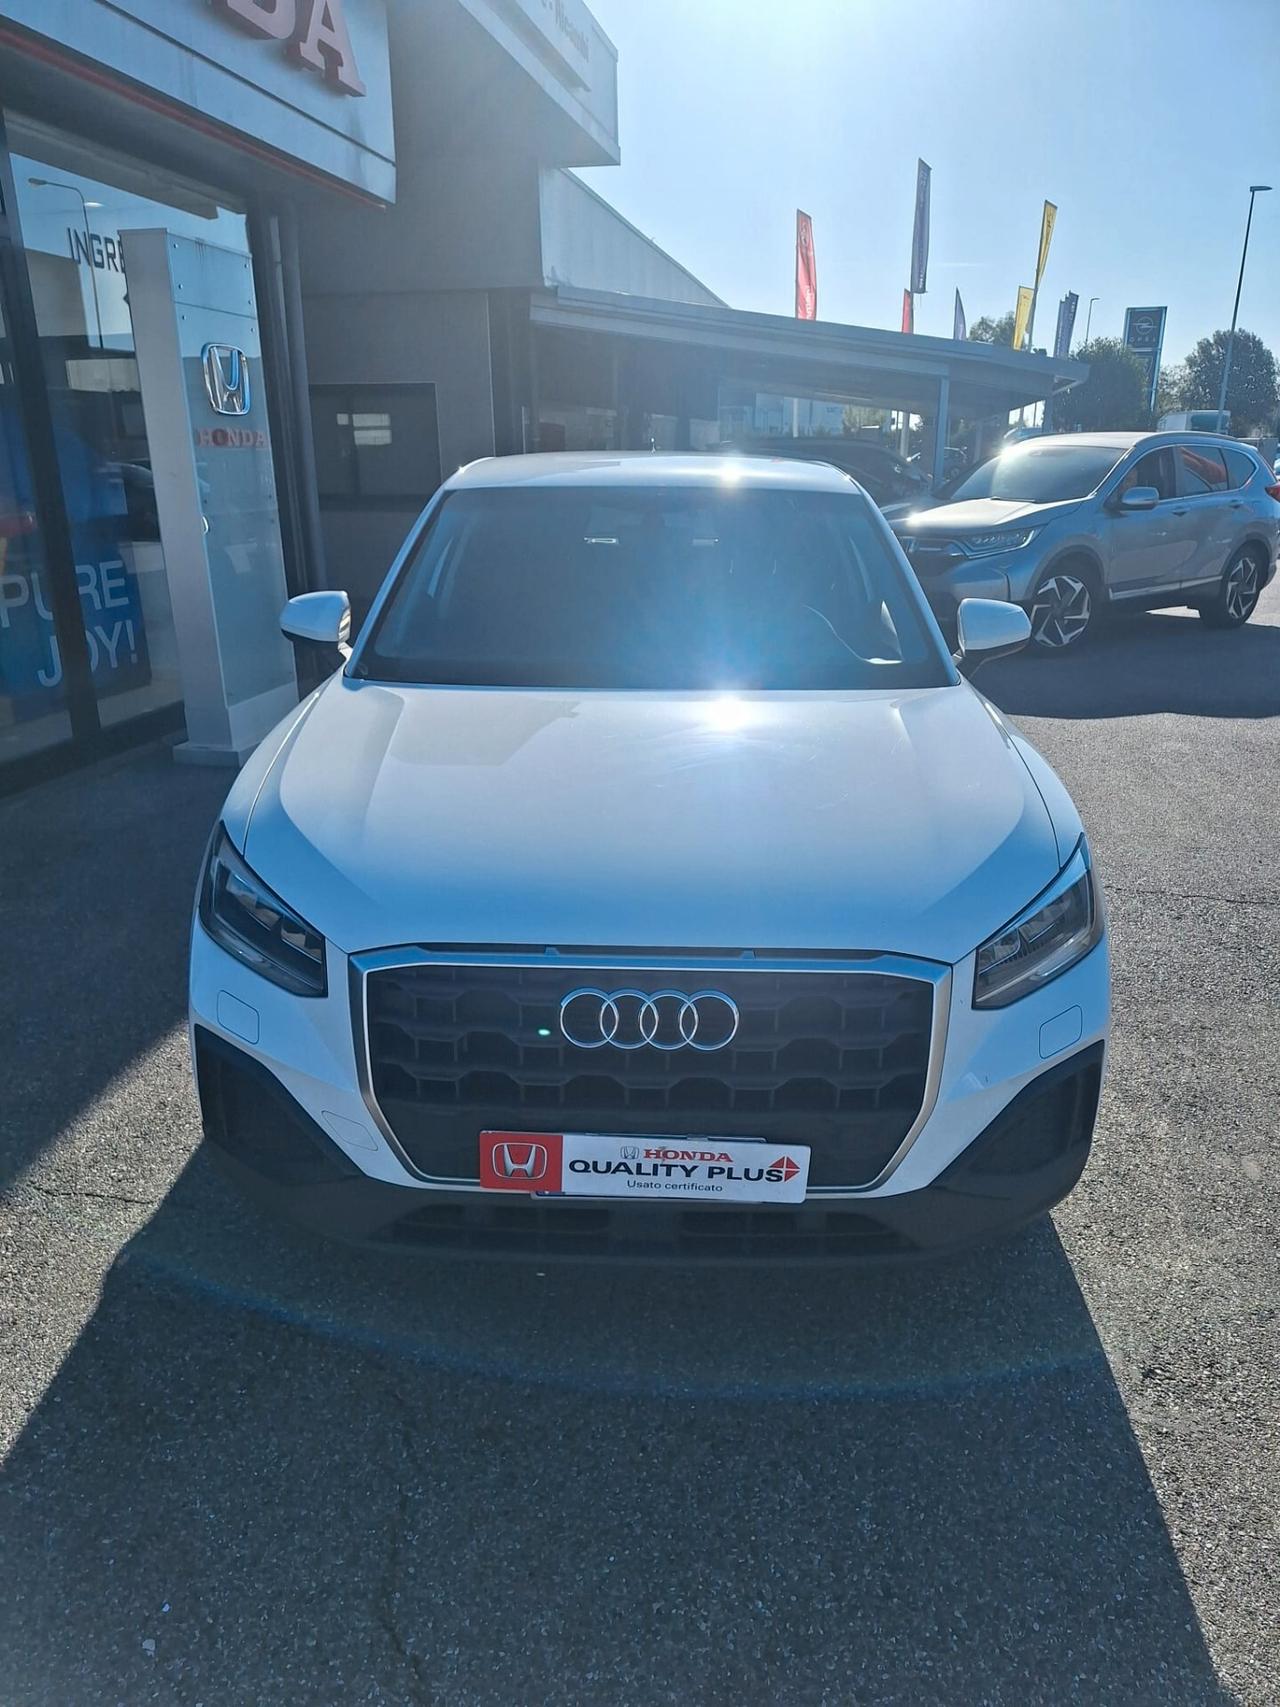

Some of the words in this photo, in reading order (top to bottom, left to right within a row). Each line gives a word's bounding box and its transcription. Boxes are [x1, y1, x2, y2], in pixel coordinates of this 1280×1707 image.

[196, 427, 270, 451] HONDA
[643, 1148, 733, 1163] HONDA
[568, 1159, 701, 1178] QUALITY
[707, 1166, 784, 1183] PLUS
[627, 1179, 662, 1190] Usato
[664, 1182, 723, 1193] certificato
